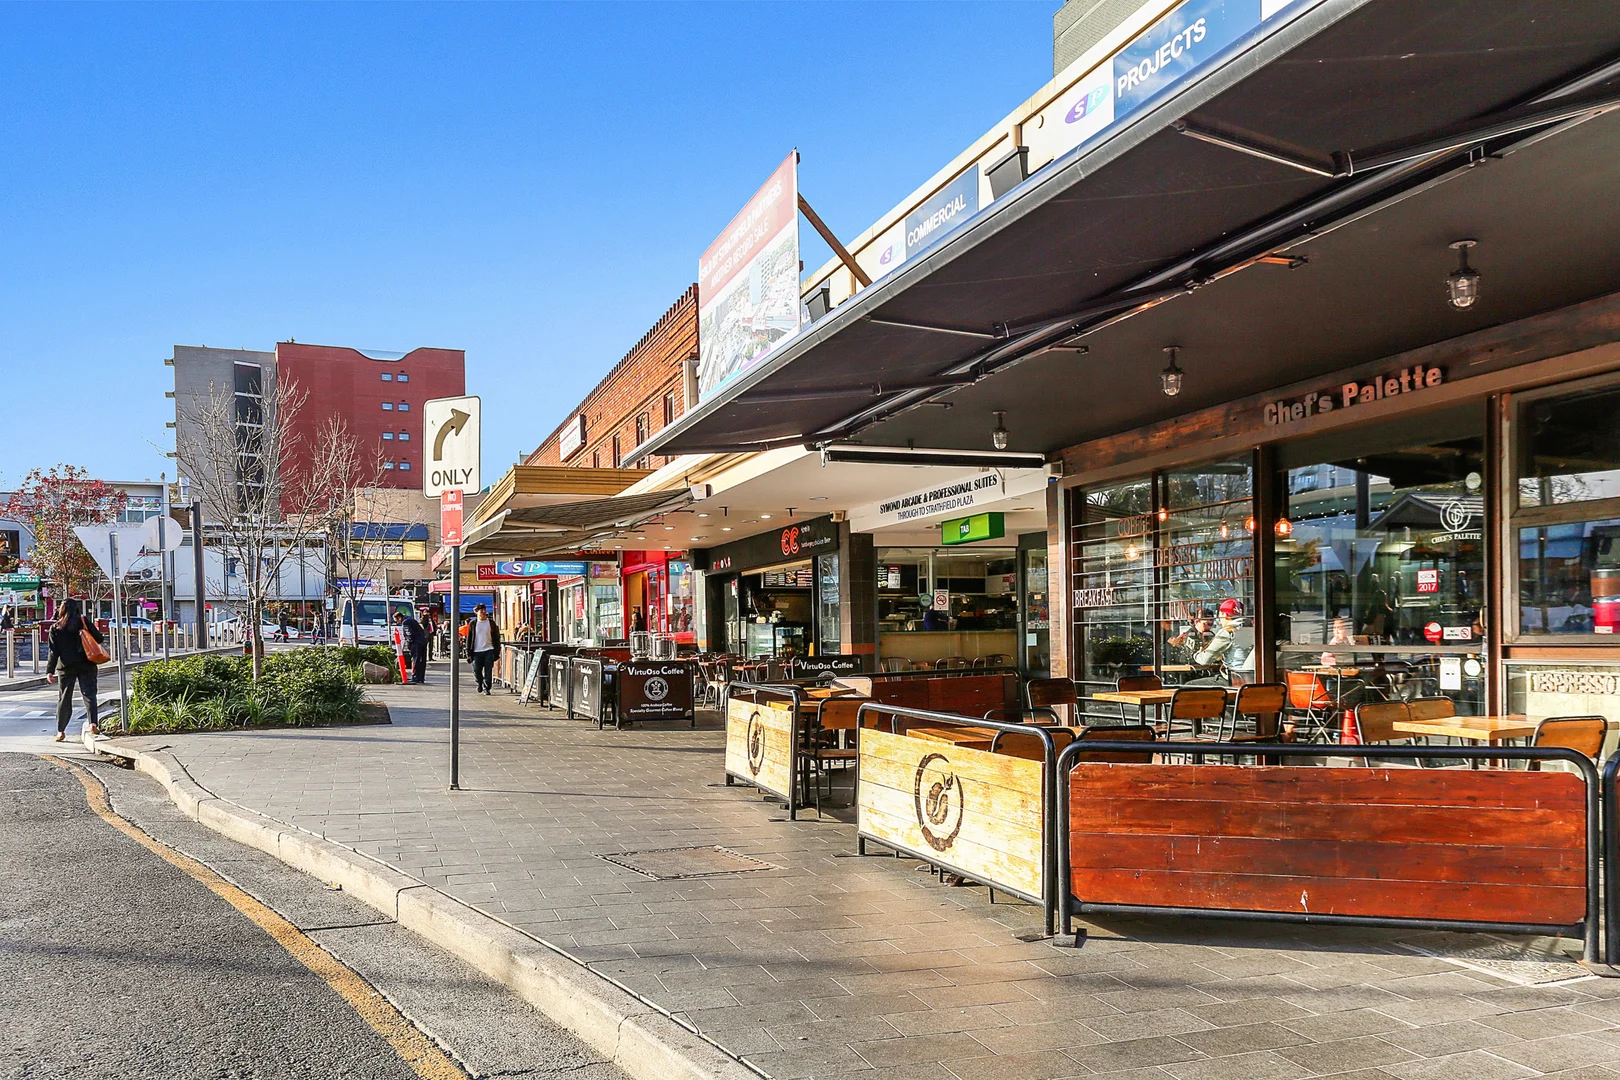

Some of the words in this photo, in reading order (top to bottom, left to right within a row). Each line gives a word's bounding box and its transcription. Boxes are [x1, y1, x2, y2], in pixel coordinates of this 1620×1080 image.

[1117, 17, 1206, 98] PROJECTS
[753, 216, 769, 244] SALE
[907, 194, 966, 247] COMMERCIAL
[1264, 392, 1333, 427] Chef's
[1342, 365, 1442, 408] Palette
[431, 467, 473, 487] ONLY
[447, 493, 457, 502] NO
[879, 500, 900, 514] SYMOND
[901, 493, 922, 509] ARCADE
[923, 493, 928, 503] &
[929, 483, 973, 501] PROFESSIONAL
[974, 473, 998, 491] SUITES
[897, 508, 919, 520] THROUGH
[919, 506, 925, 516] TO
[926, 499, 956, 515] STRATHFIELD
[957, 494, 974, 507] PLAZA
[960, 524, 970, 533] TAB
[1118, 512, 1151, 537] COFFEE
[1431, 534, 1453, 544] CHEF'S
[1156, 545, 1199, 567] DESSERT
[1206, 557, 1253, 580] BRUNCH
[1074, 588, 1114, 607] BREAKFAST
[1418, 583, 1437, 592] 2017
[1168, 600, 1203, 620] LUNCH
[627, 667, 660, 675] VirtuOso
[661, 666, 684, 675] Coffee
[801, 661, 831, 670] VirtuOso
[832, 660, 853, 669] Coffee
[1531, 673, 1617, 695] ESPRESSO
